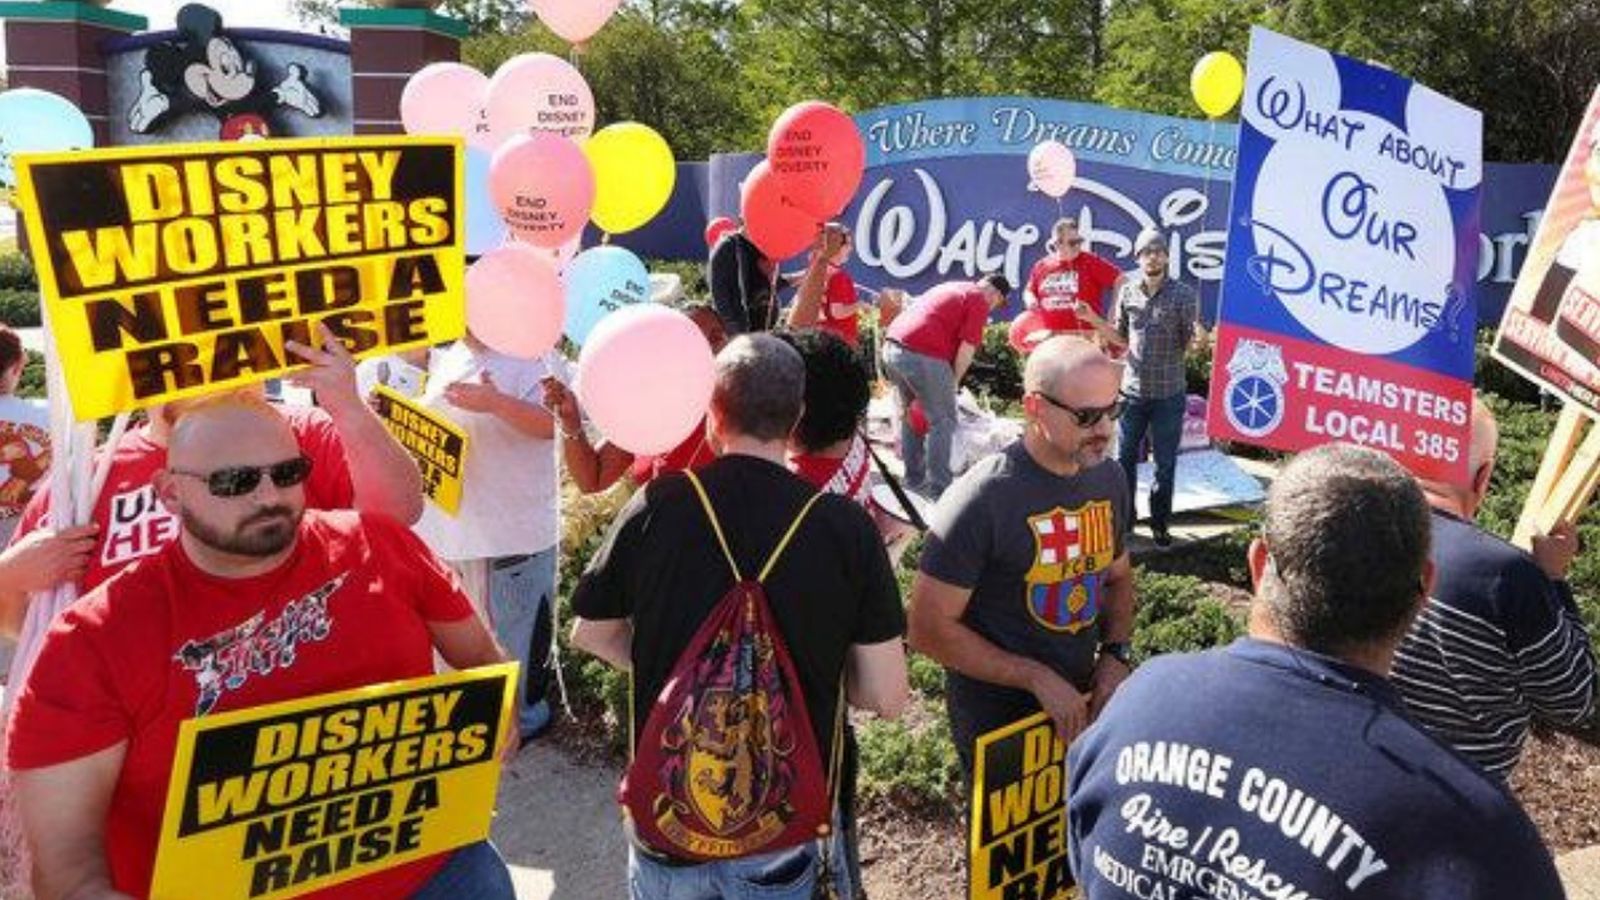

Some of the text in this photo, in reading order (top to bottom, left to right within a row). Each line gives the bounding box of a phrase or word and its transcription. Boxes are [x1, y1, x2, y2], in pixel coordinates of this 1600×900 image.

[537, 111, 586, 123] DISNEY
[547, 93, 579, 106] END
[869, 110, 977, 153] Where
[992, 106, 1136, 155] Dreams
[784, 129, 812, 141] END
[1378, 132, 1466, 187] ABOUT
[120, 150, 402, 222] DISNEY
[515, 195, 547, 209] END
[1322, 171, 1417, 260] OUR
[61, 197, 449, 290] WORKERS
[84, 253, 447, 353] NEED A
[125, 300, 430, 400] RAISE
[391, 402, 449, 448] DISNEY
[1293, 361, 1468, 426] TEAMSTERS
[1305, 406, 1460, 463] LOCAL 385
[252, 691, 464, 768] DISNEY
[198, 722, 489, 826] WORKERS
[242, 776, 440, 860] NEED A
[1115, 741, 1387, 891] ORANGE COUNTY
[1120, 793, 1190, 849] Fire
[249, 817, 424, 898] RAISE
